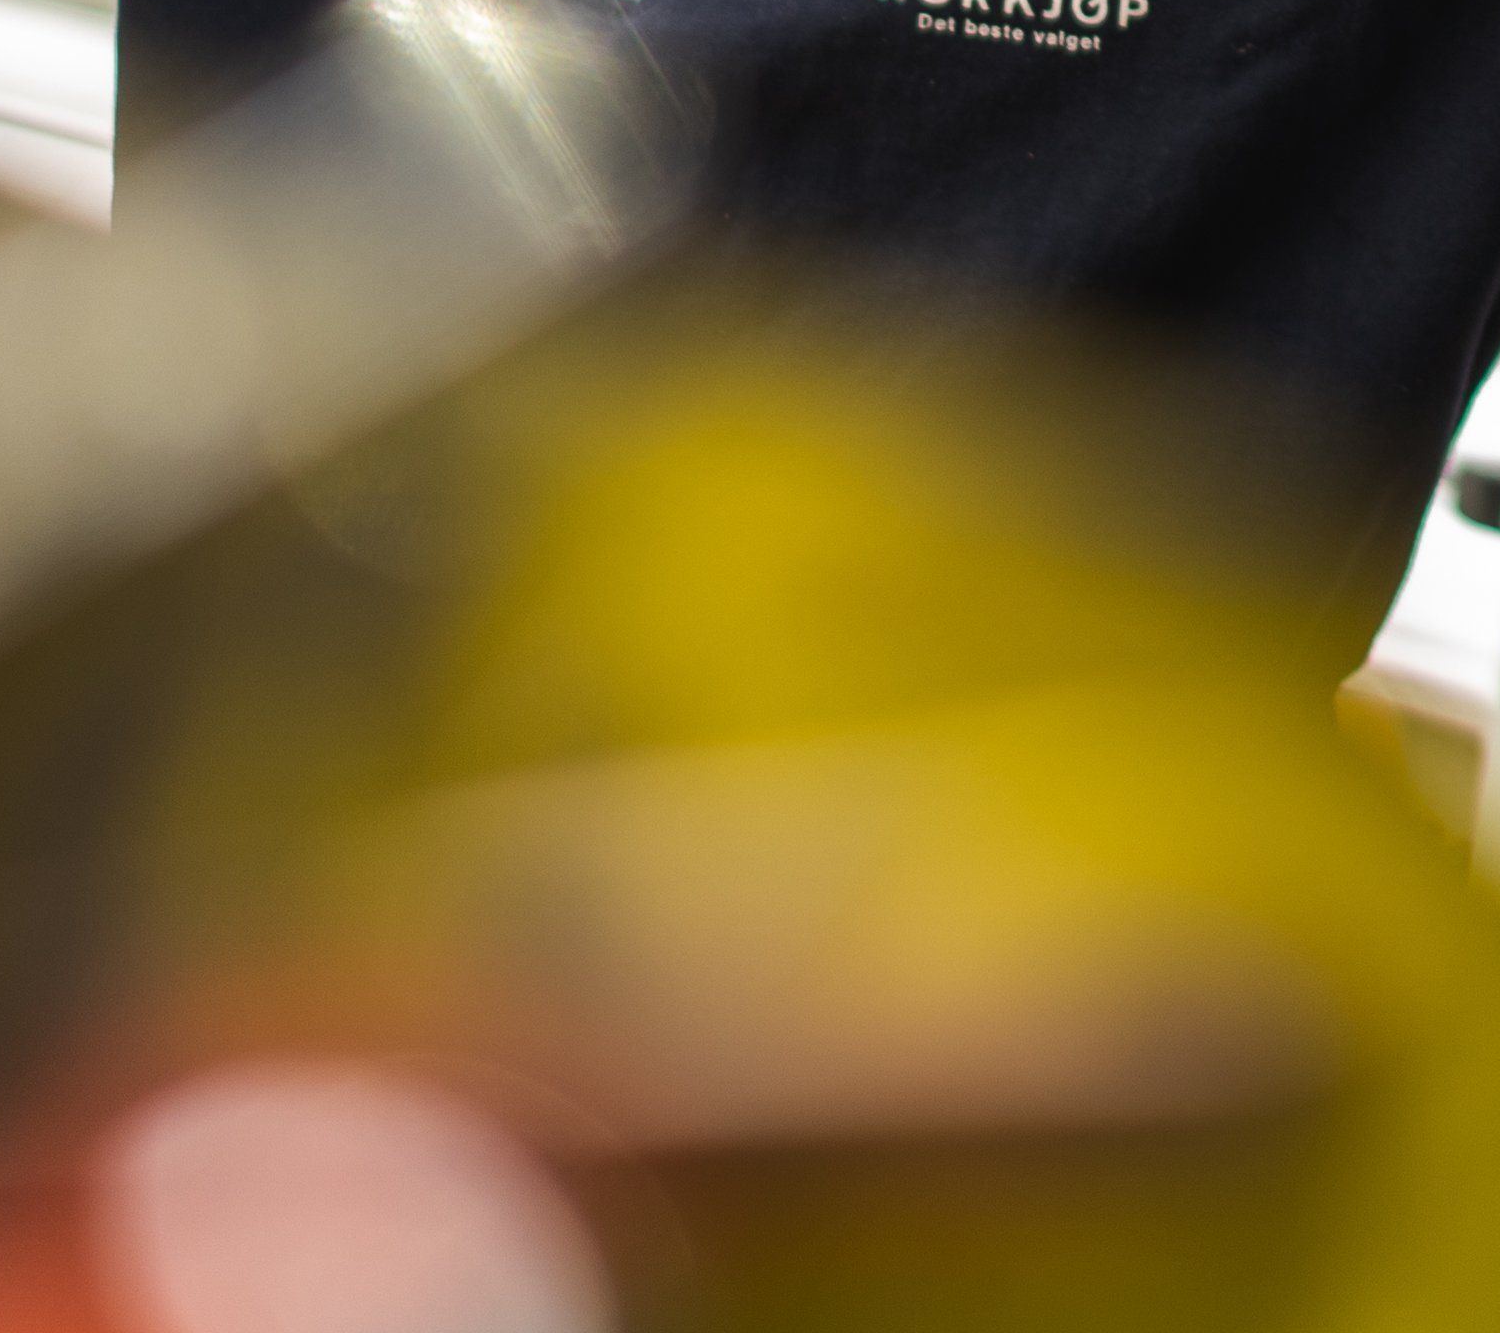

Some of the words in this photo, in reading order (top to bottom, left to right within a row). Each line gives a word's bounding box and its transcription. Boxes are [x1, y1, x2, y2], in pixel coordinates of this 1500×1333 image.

[917, 12, 956, 32] Det
[964, 18, 1025, 42] beste
[1033, 30, 1101, 53] valget
